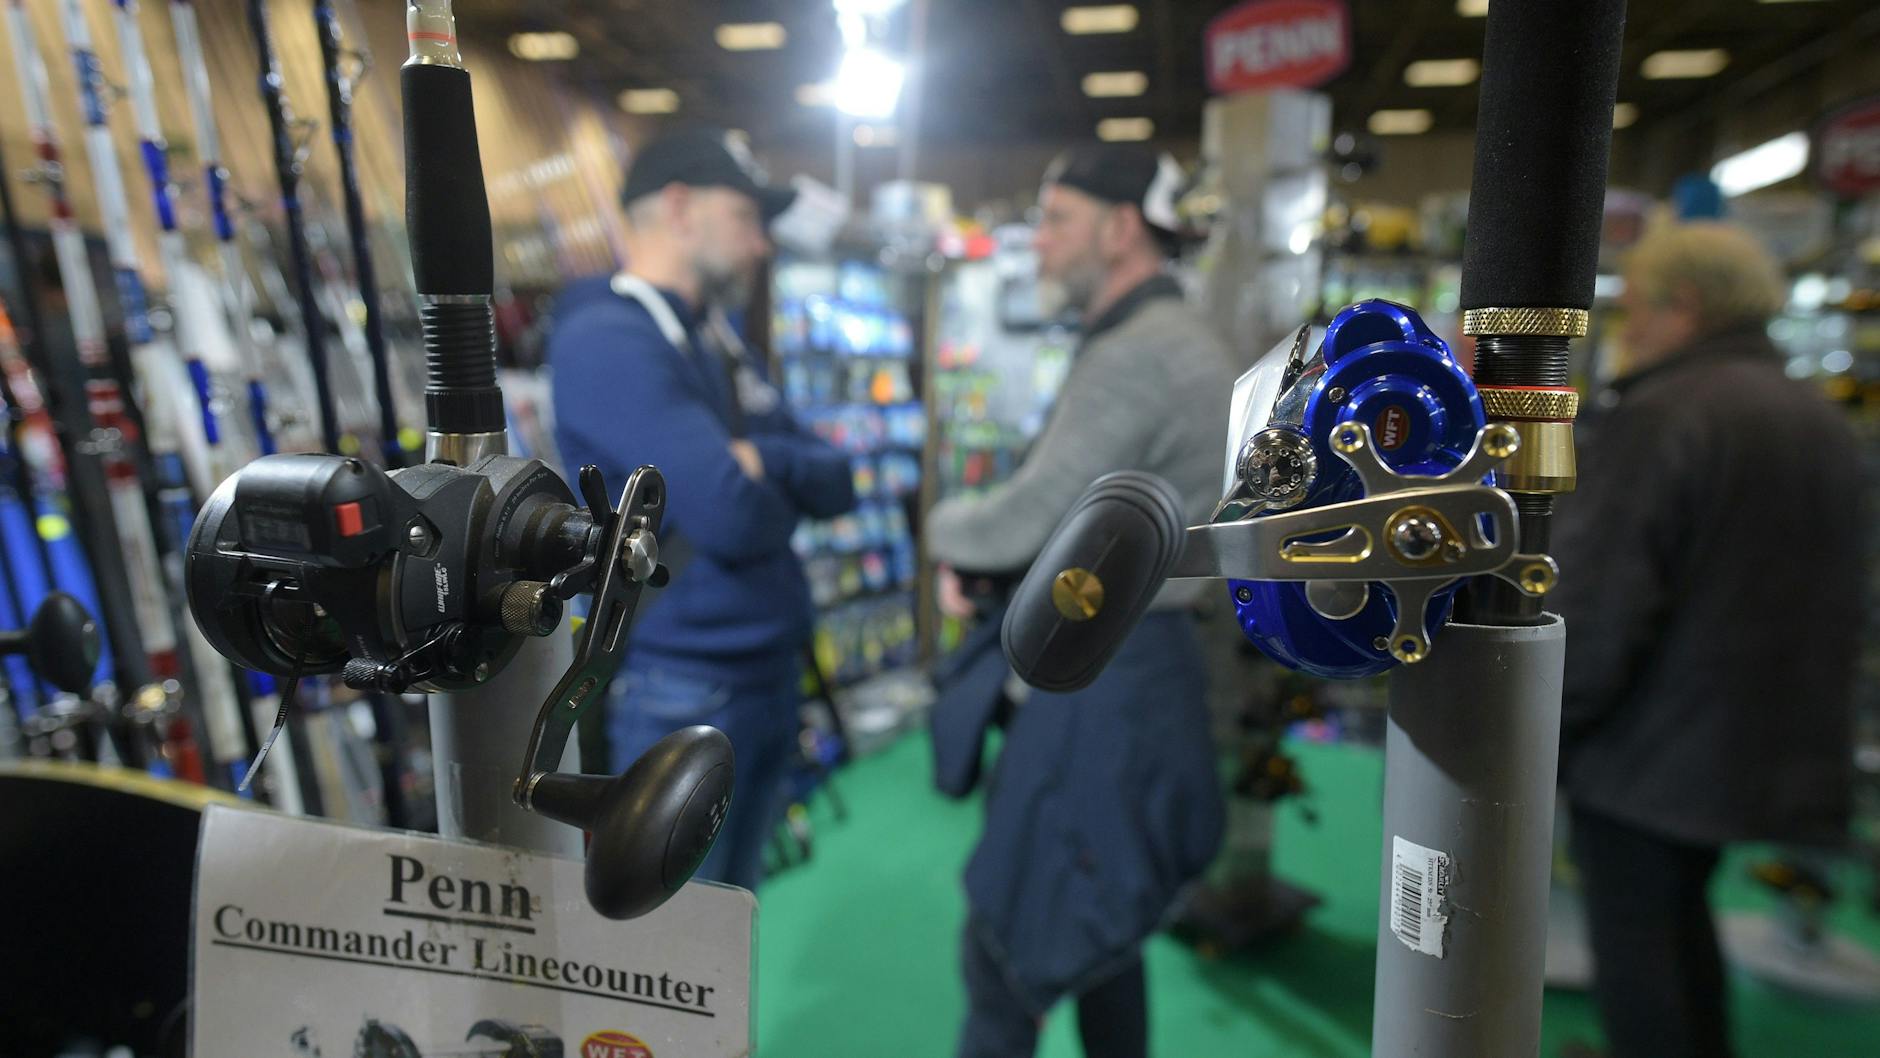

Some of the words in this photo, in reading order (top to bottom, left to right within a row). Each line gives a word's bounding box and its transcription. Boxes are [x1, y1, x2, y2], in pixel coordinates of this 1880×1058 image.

[1212, 12, 1342, 80] PENN
[1383, 409, 1400, 447] WFT
[386, 853, 533, 920] Penn
[213, 904, 457, 965] Commander
[474, 937, 715, 1007] Linecounter
